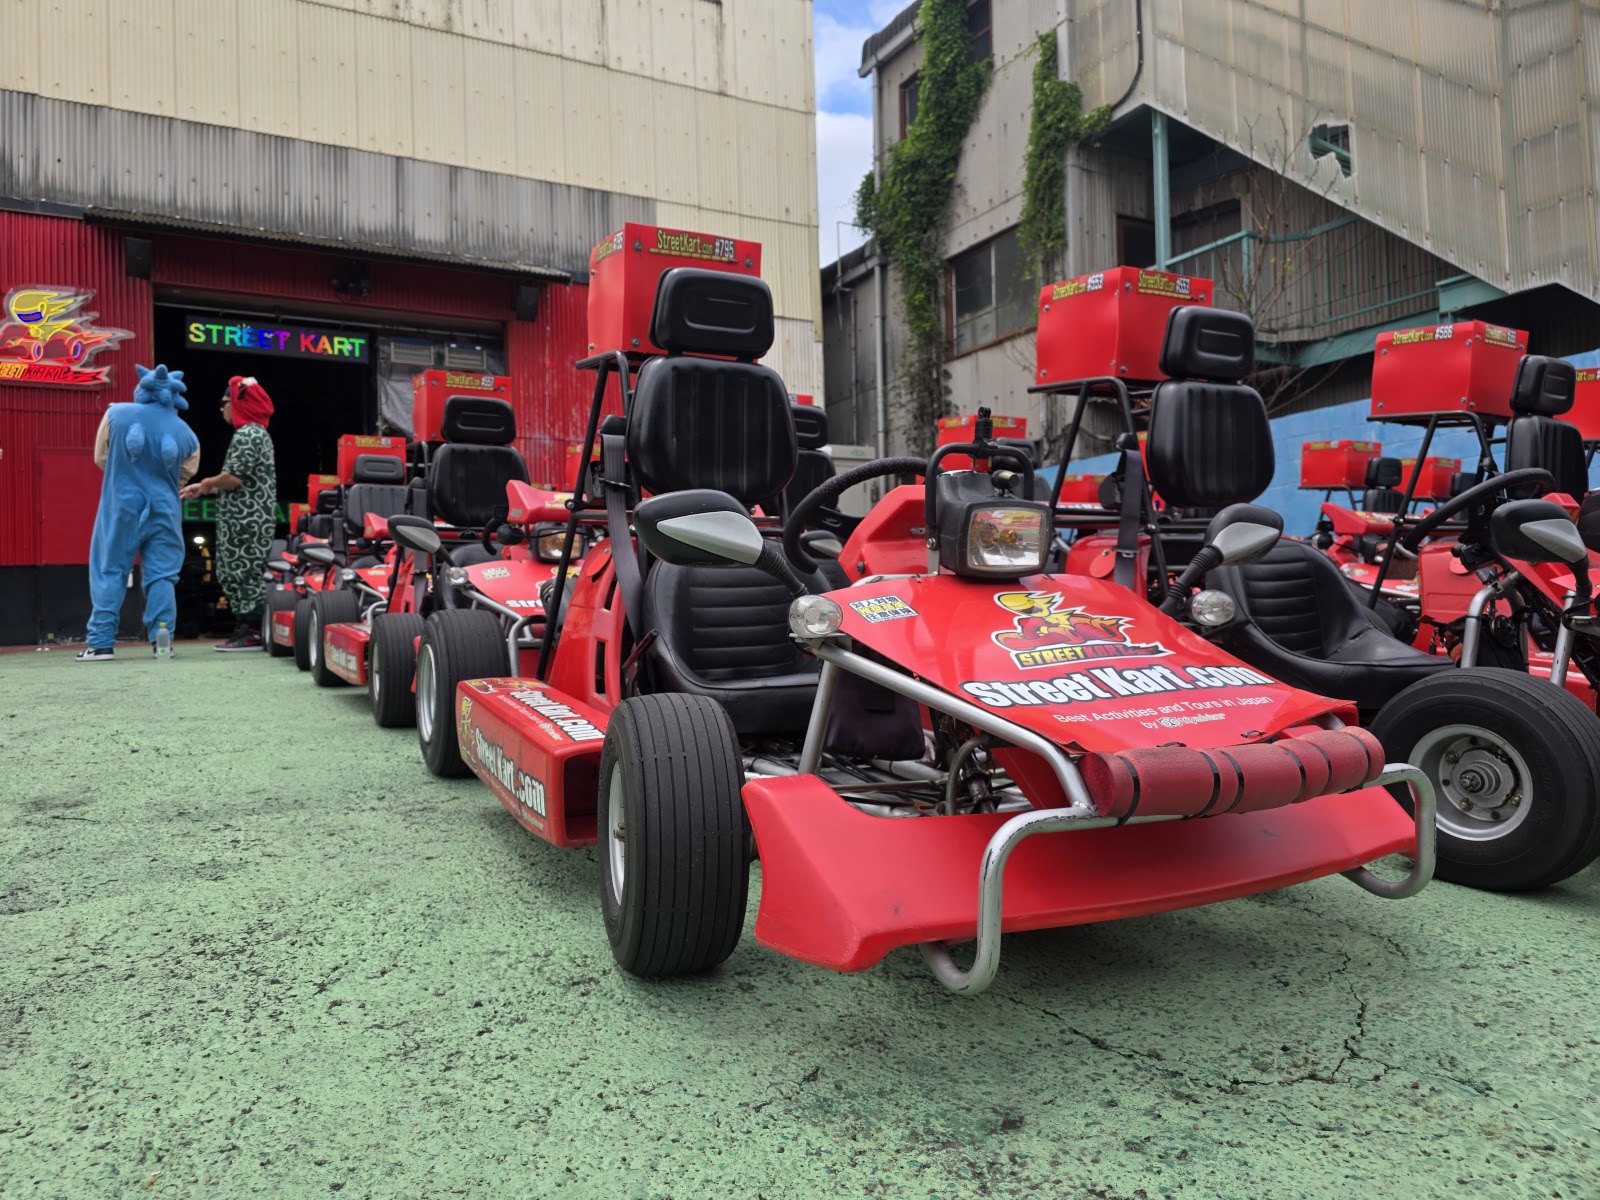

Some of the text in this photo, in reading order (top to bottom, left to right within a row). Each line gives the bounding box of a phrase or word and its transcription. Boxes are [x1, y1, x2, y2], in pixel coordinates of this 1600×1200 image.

[714, 238, 735, 258] #795
[188, 322, 366, 358] STREET KART
[1434, 325, 1454, 341] #566
[961, 672, 1114, 708] Street
[1053, 695, 1275, 724] Best Activities and Tours in Japan
[1140, 719, 1159, 730] by
